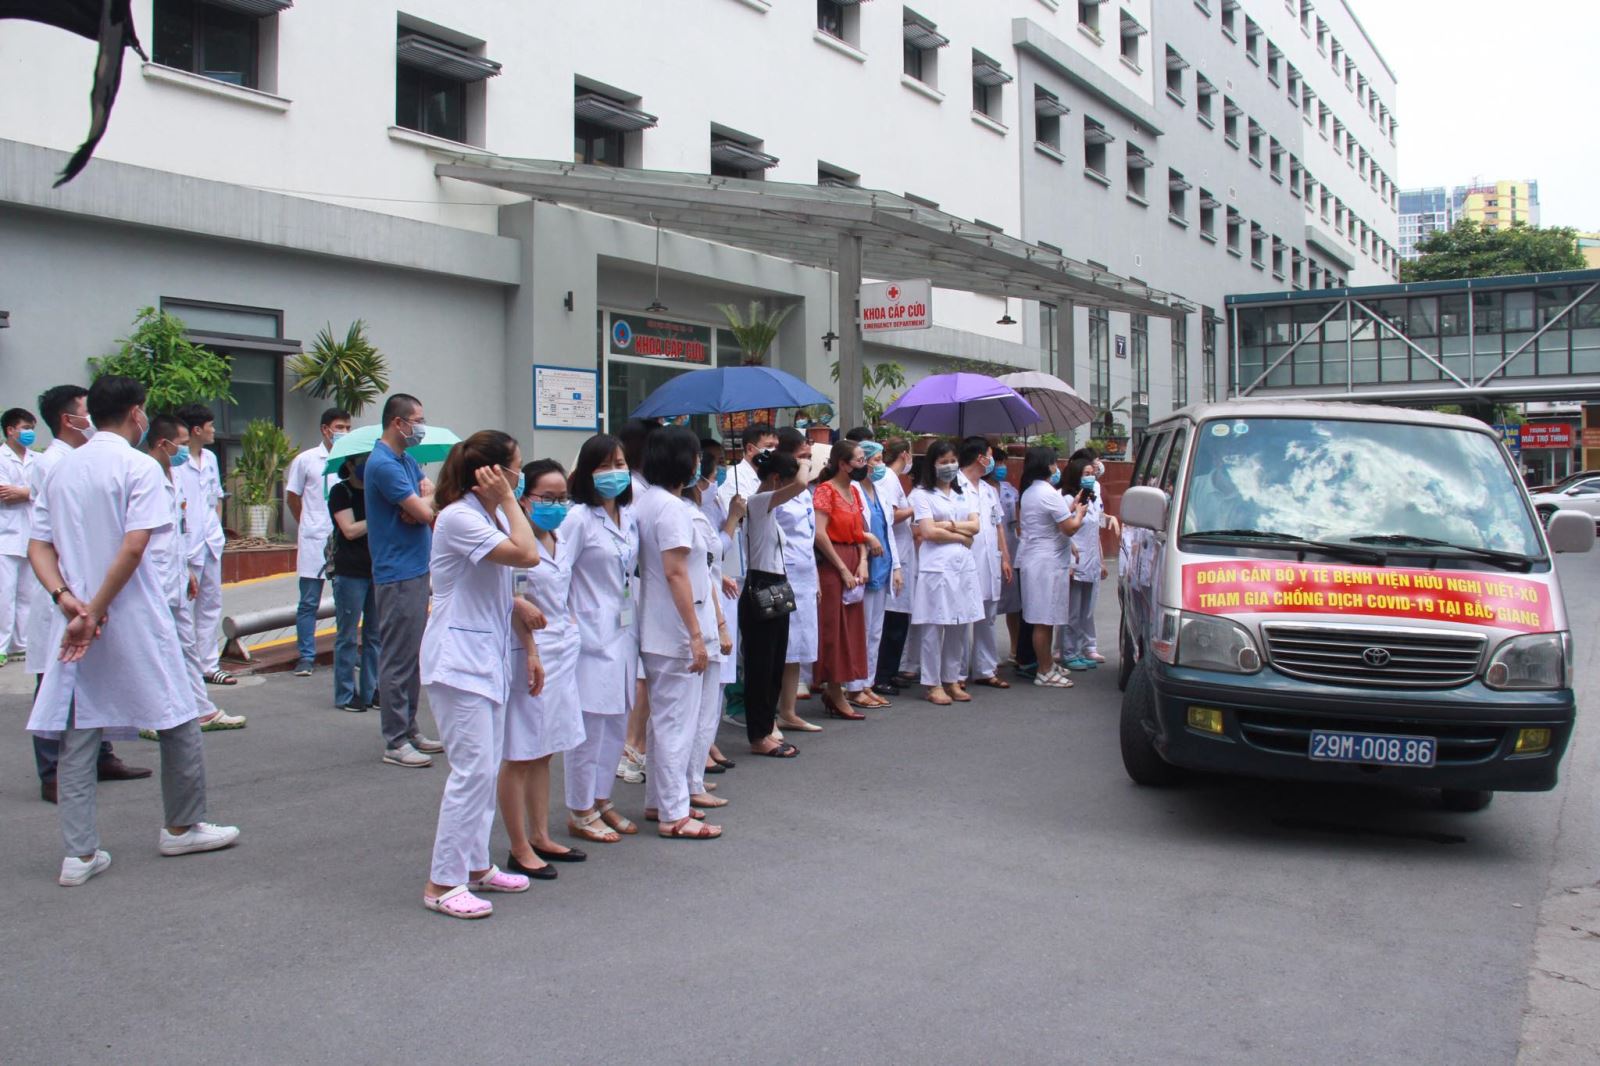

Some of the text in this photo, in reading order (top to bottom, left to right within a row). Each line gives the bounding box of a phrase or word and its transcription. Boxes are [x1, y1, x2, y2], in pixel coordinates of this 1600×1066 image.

[863, 300, 926, 321] KHOA CẤP CỨU
[893, 320, 926, 328] DEPARTMENT
[635, 335, 662, 356] KHOA
[1118, 342, 1123, 354] 7
[1197, 566, 1538, 603] ĐOÀN CÁN BỘ Y TẾ BỆNH VIỆN HỮU NGHỊ VIỆT-XÔ
[1199, 587, 1540, 626] THAM GIA CHỐNG DỊCH COVID-19 TẠI BẮC GIANG
[1313, 735, 1432, 763] 29M-008.86
